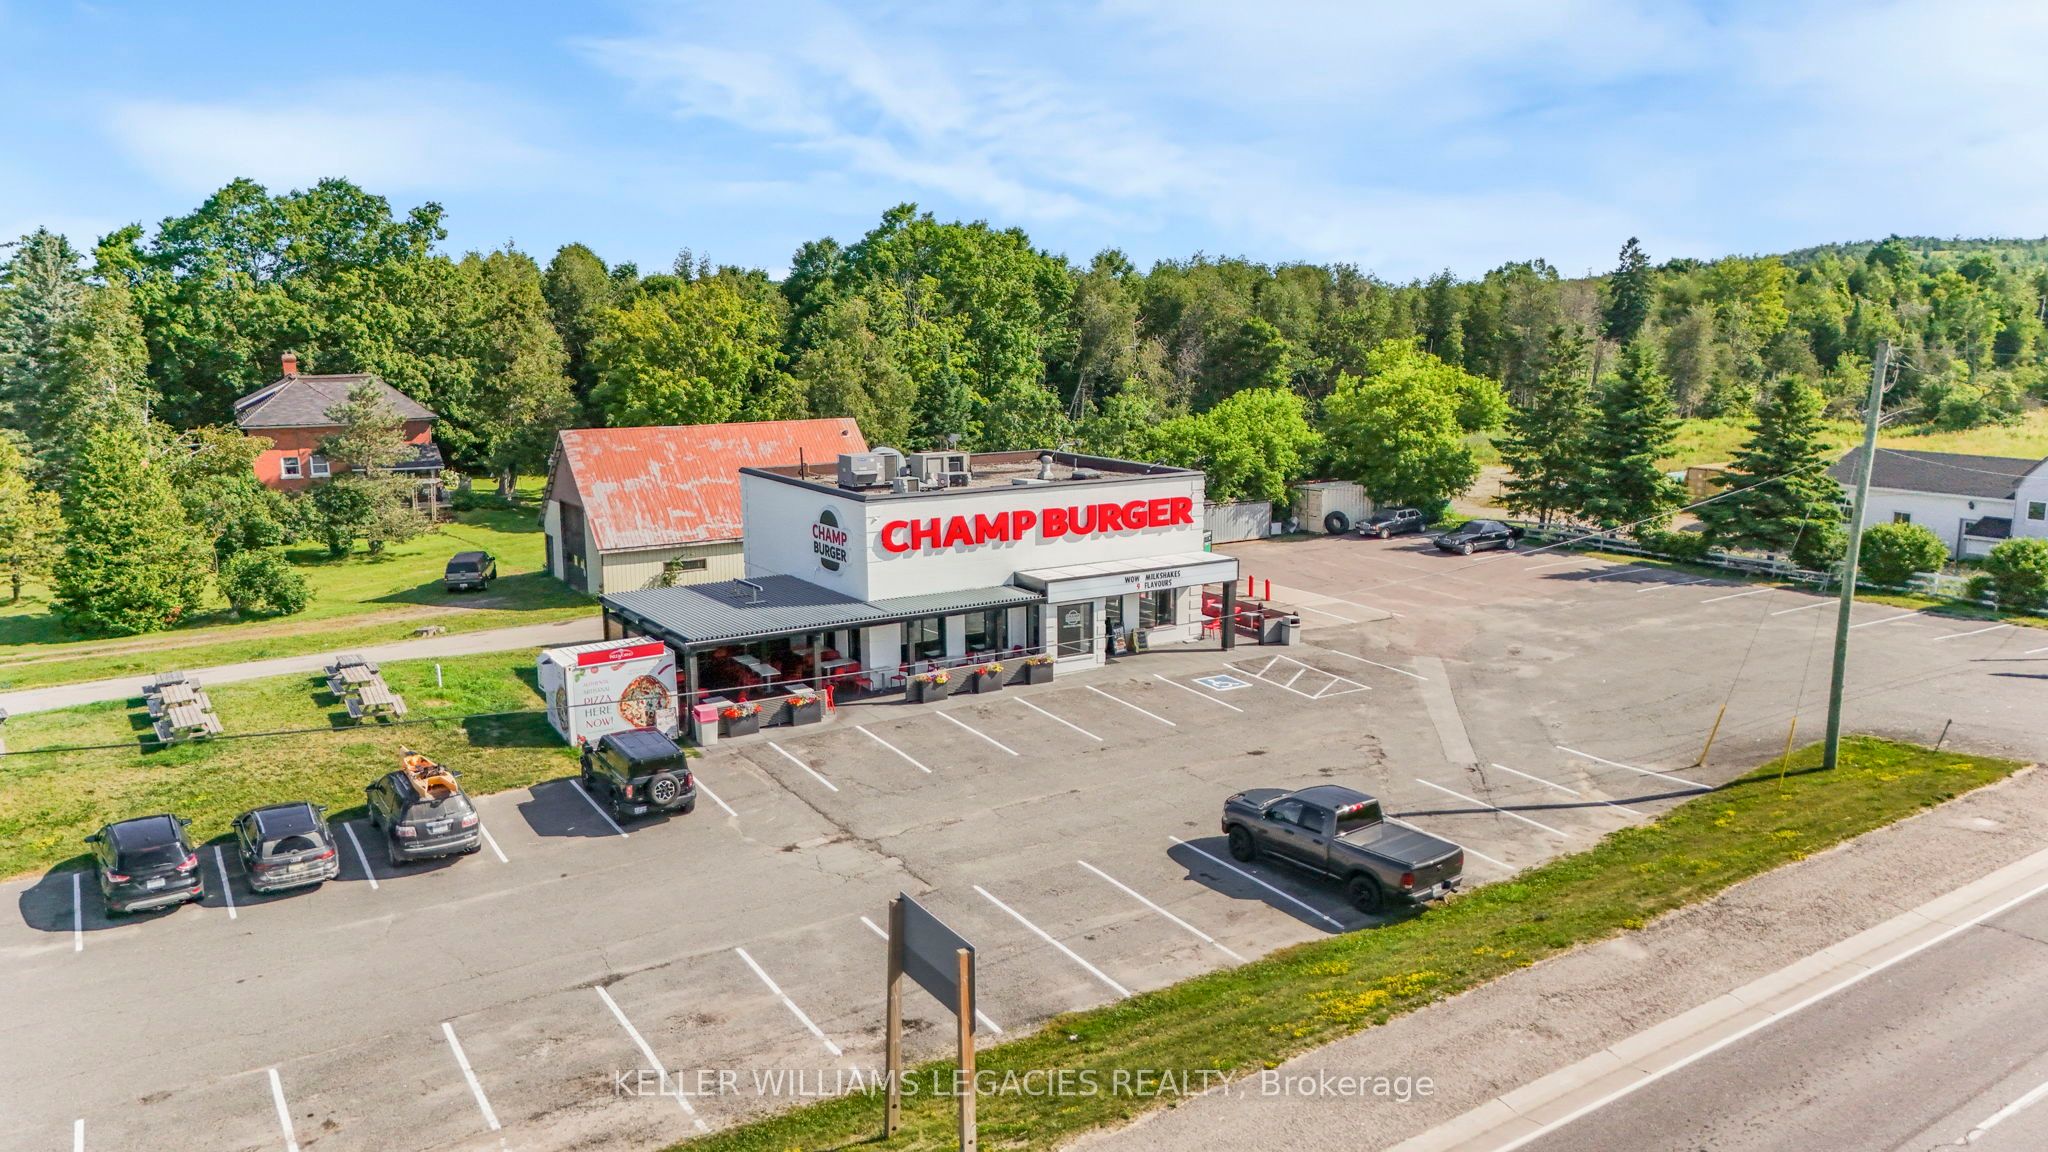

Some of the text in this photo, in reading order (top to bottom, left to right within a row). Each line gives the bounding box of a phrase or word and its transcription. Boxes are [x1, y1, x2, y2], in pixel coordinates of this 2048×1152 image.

[881, 497, 1194, 553] CHAMP BURGER
[812, 523, 848, 547] CHAMP
[813, 540, 847, 563] BURGER
[1124, 570, 1181, 583] WOW MILKSHAKES
[1144, 579, 1172, 589] FLAVOURS
[584, 694, 612, 705] PIZZA
[585, 706, 612, 717] HERE
[585, 716, 614, 728] NOW!
